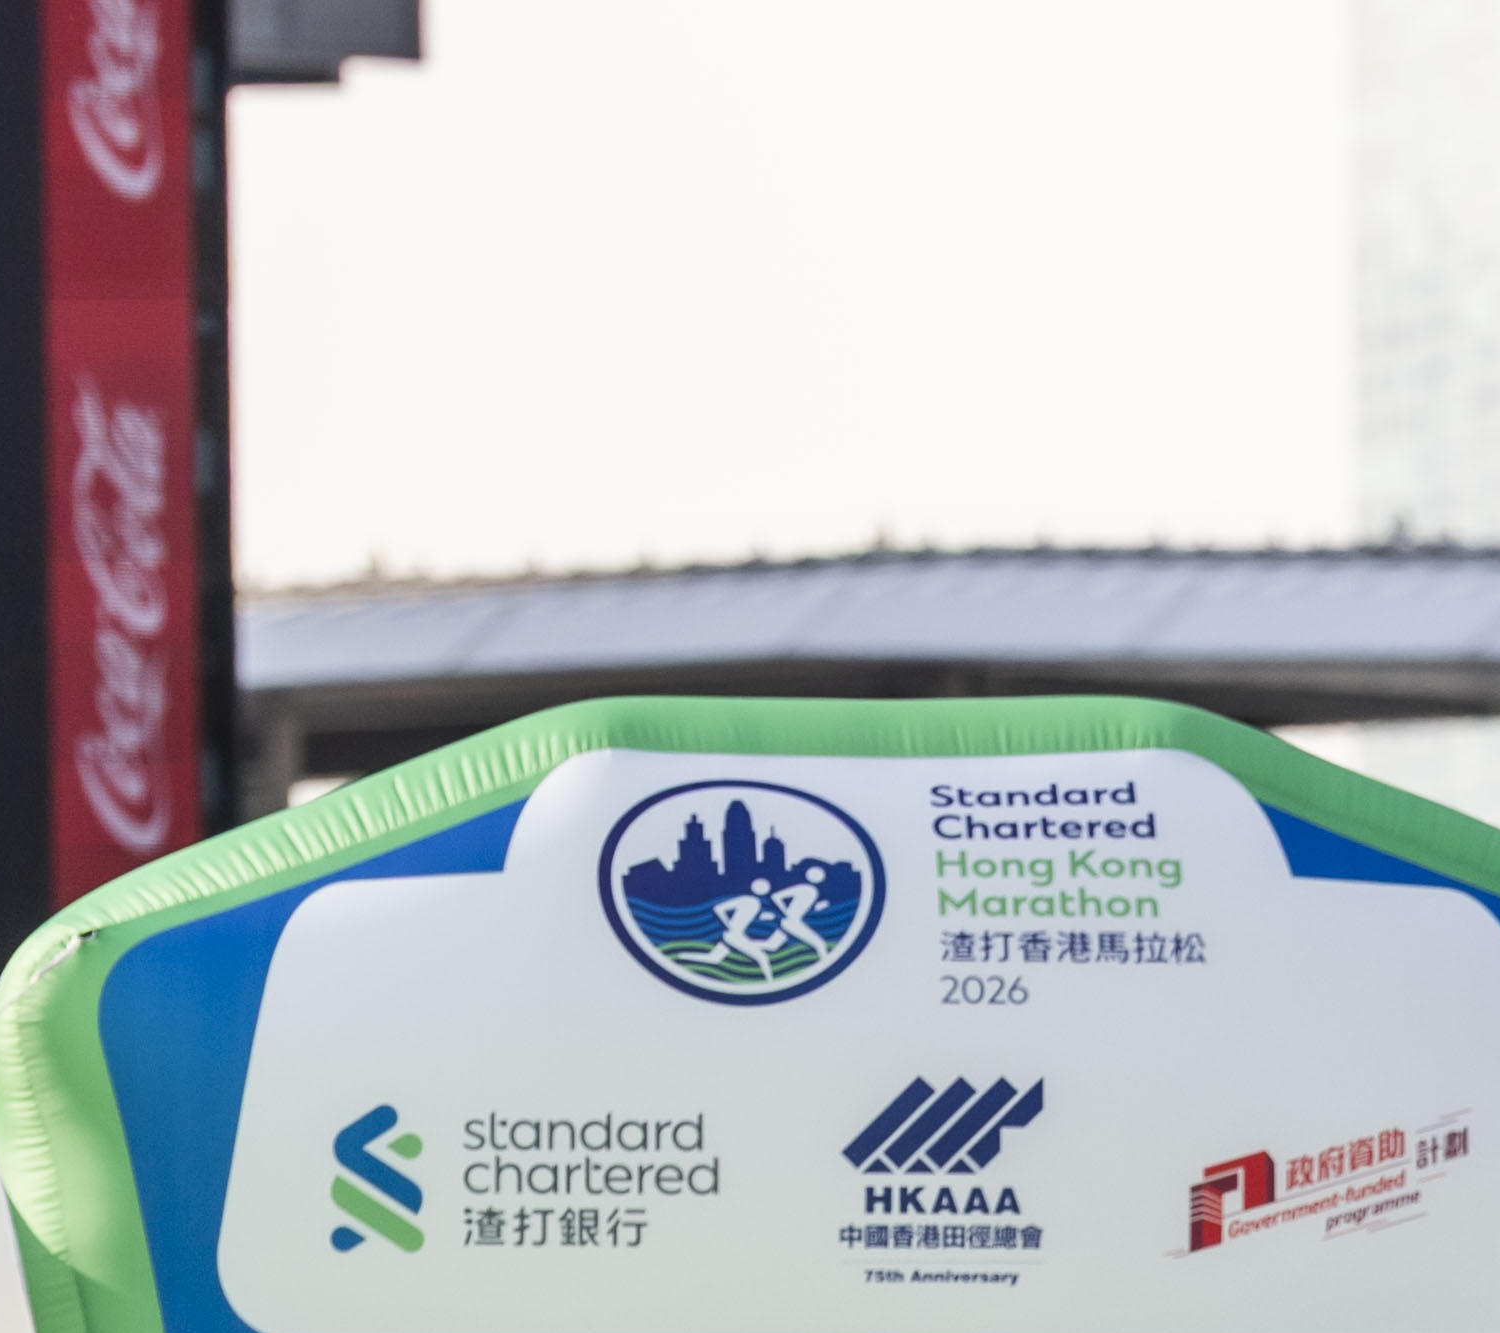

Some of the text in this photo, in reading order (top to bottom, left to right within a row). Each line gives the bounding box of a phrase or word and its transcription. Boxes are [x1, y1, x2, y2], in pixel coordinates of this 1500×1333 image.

[930, 781, 1137, 808] Standard
[933, 812, 1157, 840] Chartered
[936, 848, 1184, 889] Hong Kong
[937, 886, 1160, 918] Marathon
[940, 930, 1207, 965] 渣打香港馬拉松
[940, 974, 1029, 1006] 2026
[463, 1112, 704, 1152] standard
[463, 1156, 720, 1196] chartered
[864, 1185, 1021, 1215] HKAAA
[1227, 1170, 1408, 1240] Government-funded
[1324, 1189, 1422, 1233] programme
[463, 1206, 649, 1248] 渣打銀行
[838, 1223, 1045, 1250] 中國香港田徑總會
[863, 1268, 1020, 1288] 75th Anniversary
